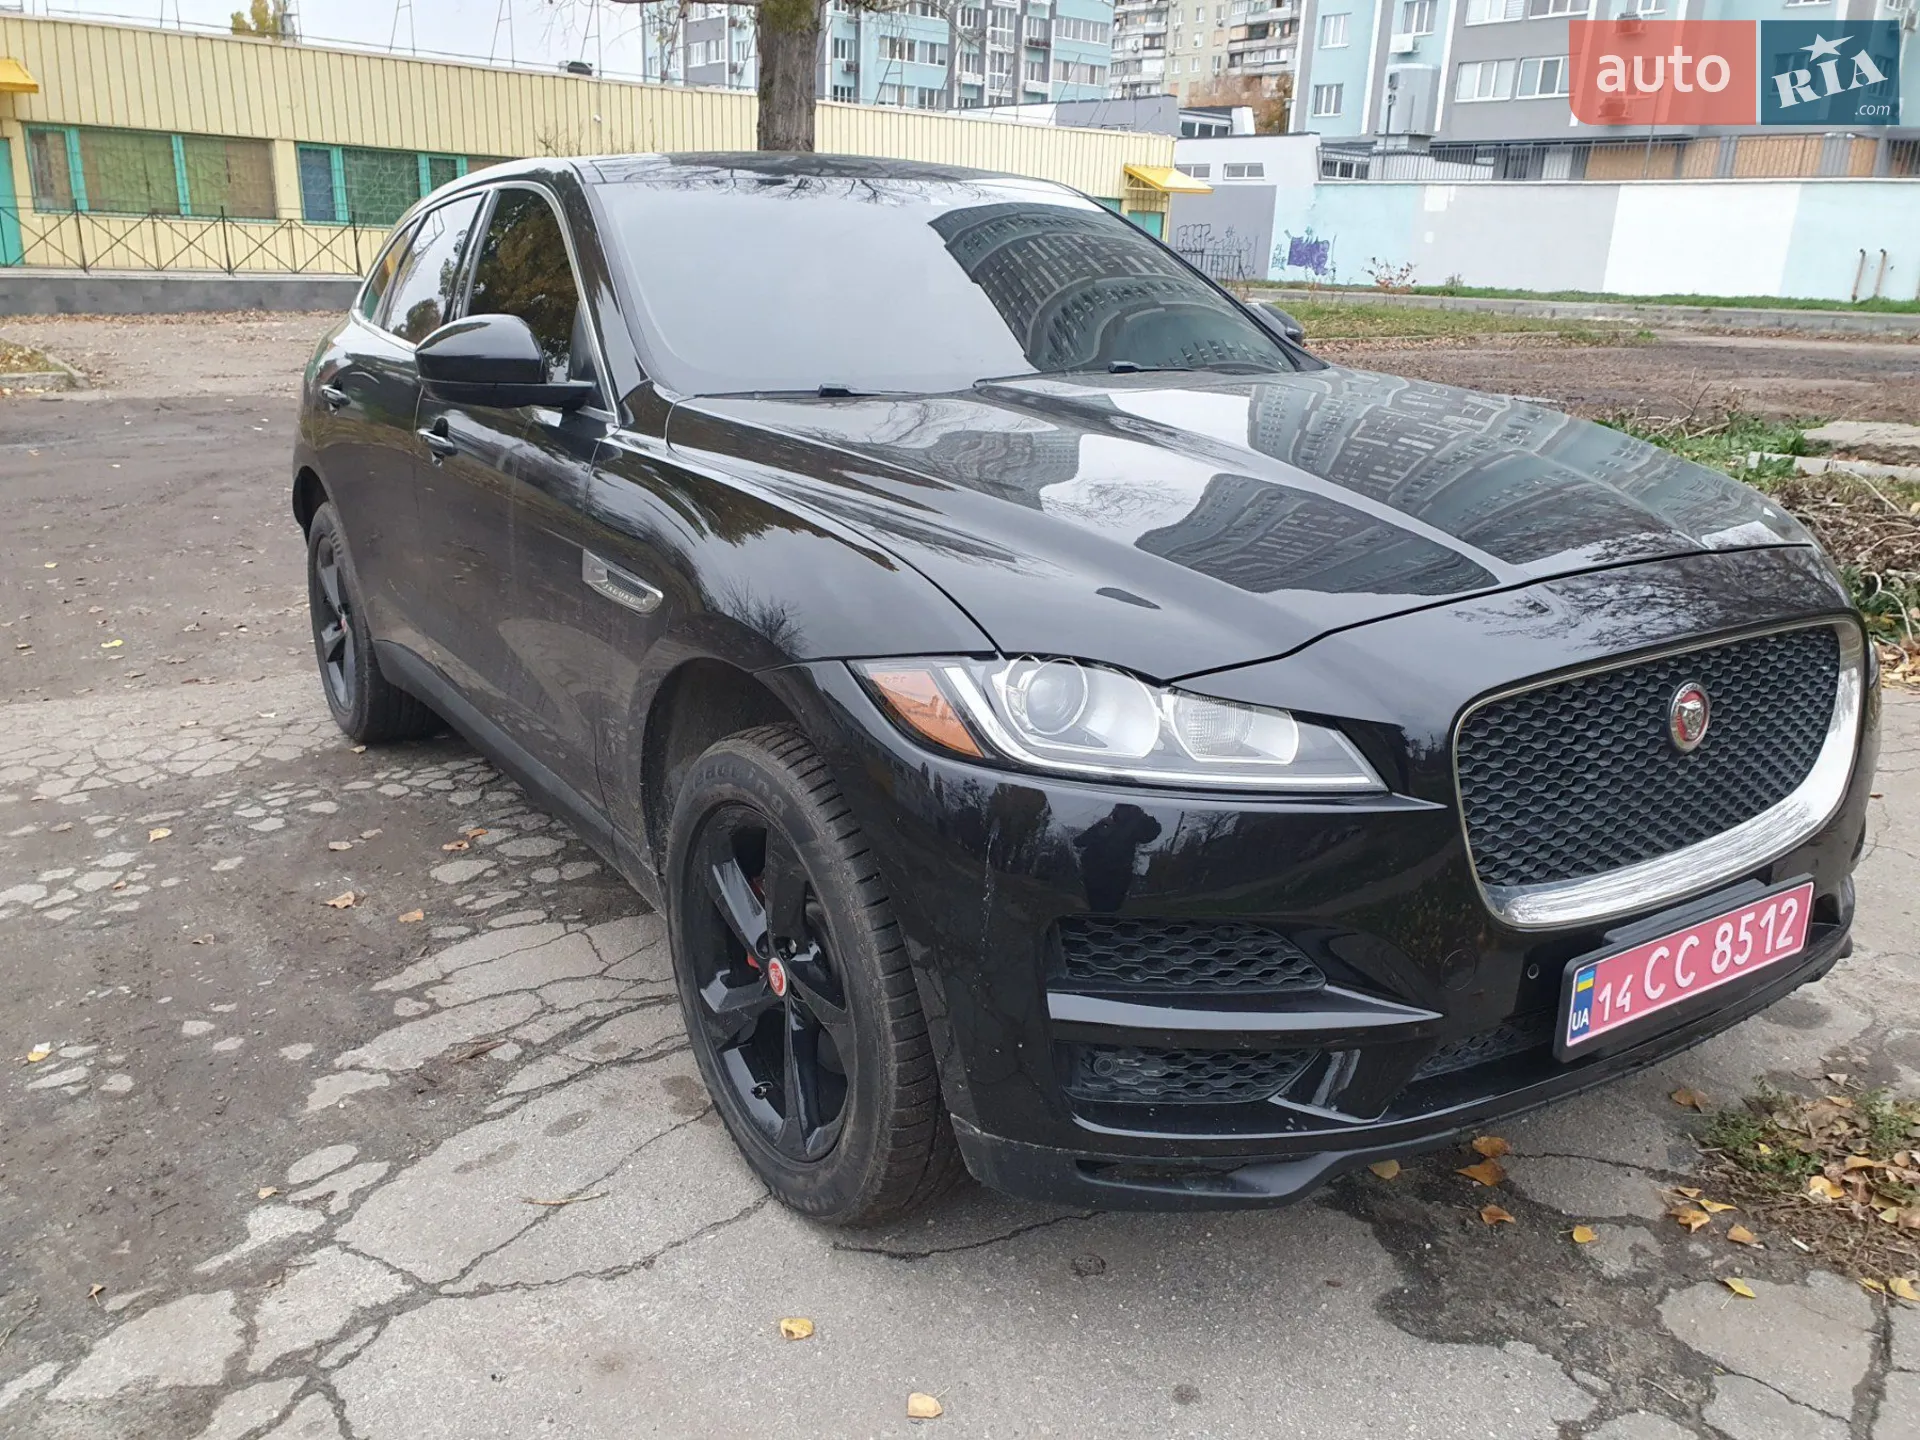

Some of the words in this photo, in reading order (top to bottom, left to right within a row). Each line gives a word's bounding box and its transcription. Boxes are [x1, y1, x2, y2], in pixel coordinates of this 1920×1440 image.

[1597, 974, 1634, 1022] 14
[1644, 935, 1700, 1001] CC
[1711, 898, 1798, 975] 8512
[1571, 1007, 1589, 1031] UA
